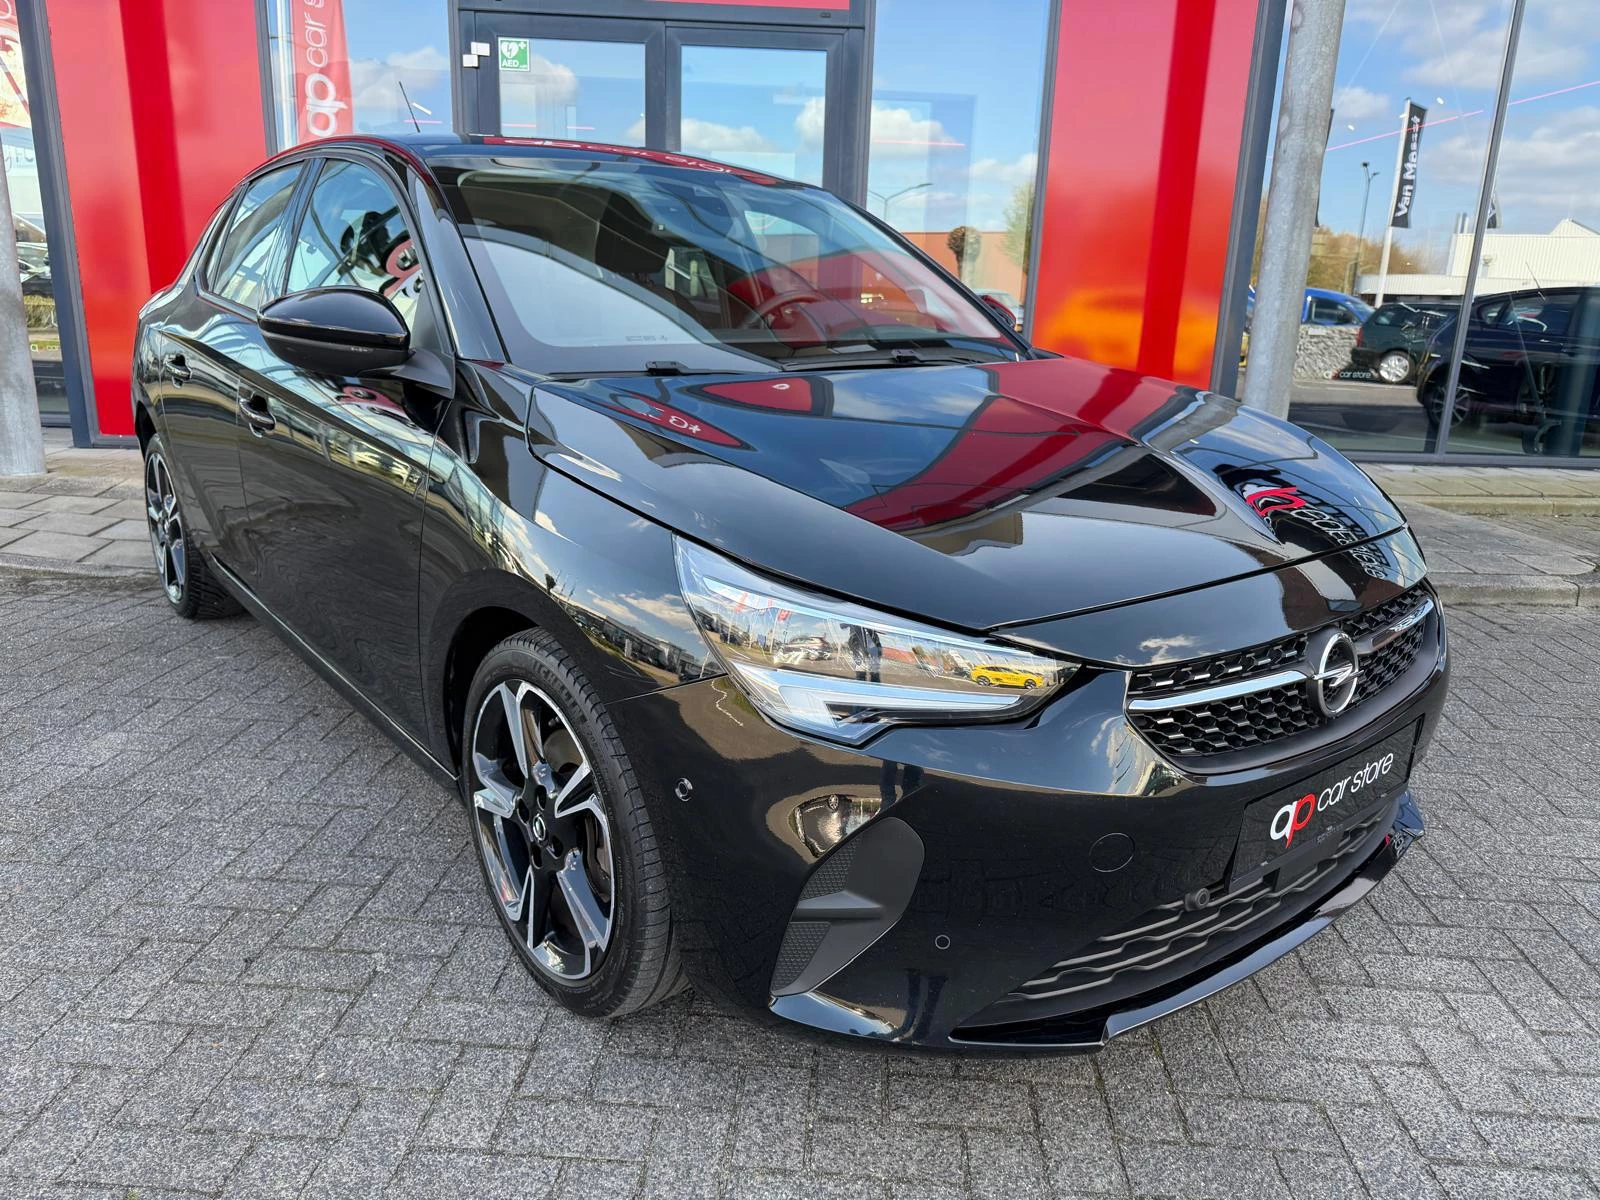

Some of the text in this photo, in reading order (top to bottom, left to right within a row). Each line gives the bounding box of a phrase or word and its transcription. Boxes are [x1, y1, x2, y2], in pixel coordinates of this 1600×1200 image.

[304, 11, 328, 68] car
[501, 59, 519, 68] AED
[1395, 184, 1413, 217] Van
[1352, 371, 1372, 379] store
[1317, 776, 1351, 812] car
[1350, 752, 1394, 793] store
